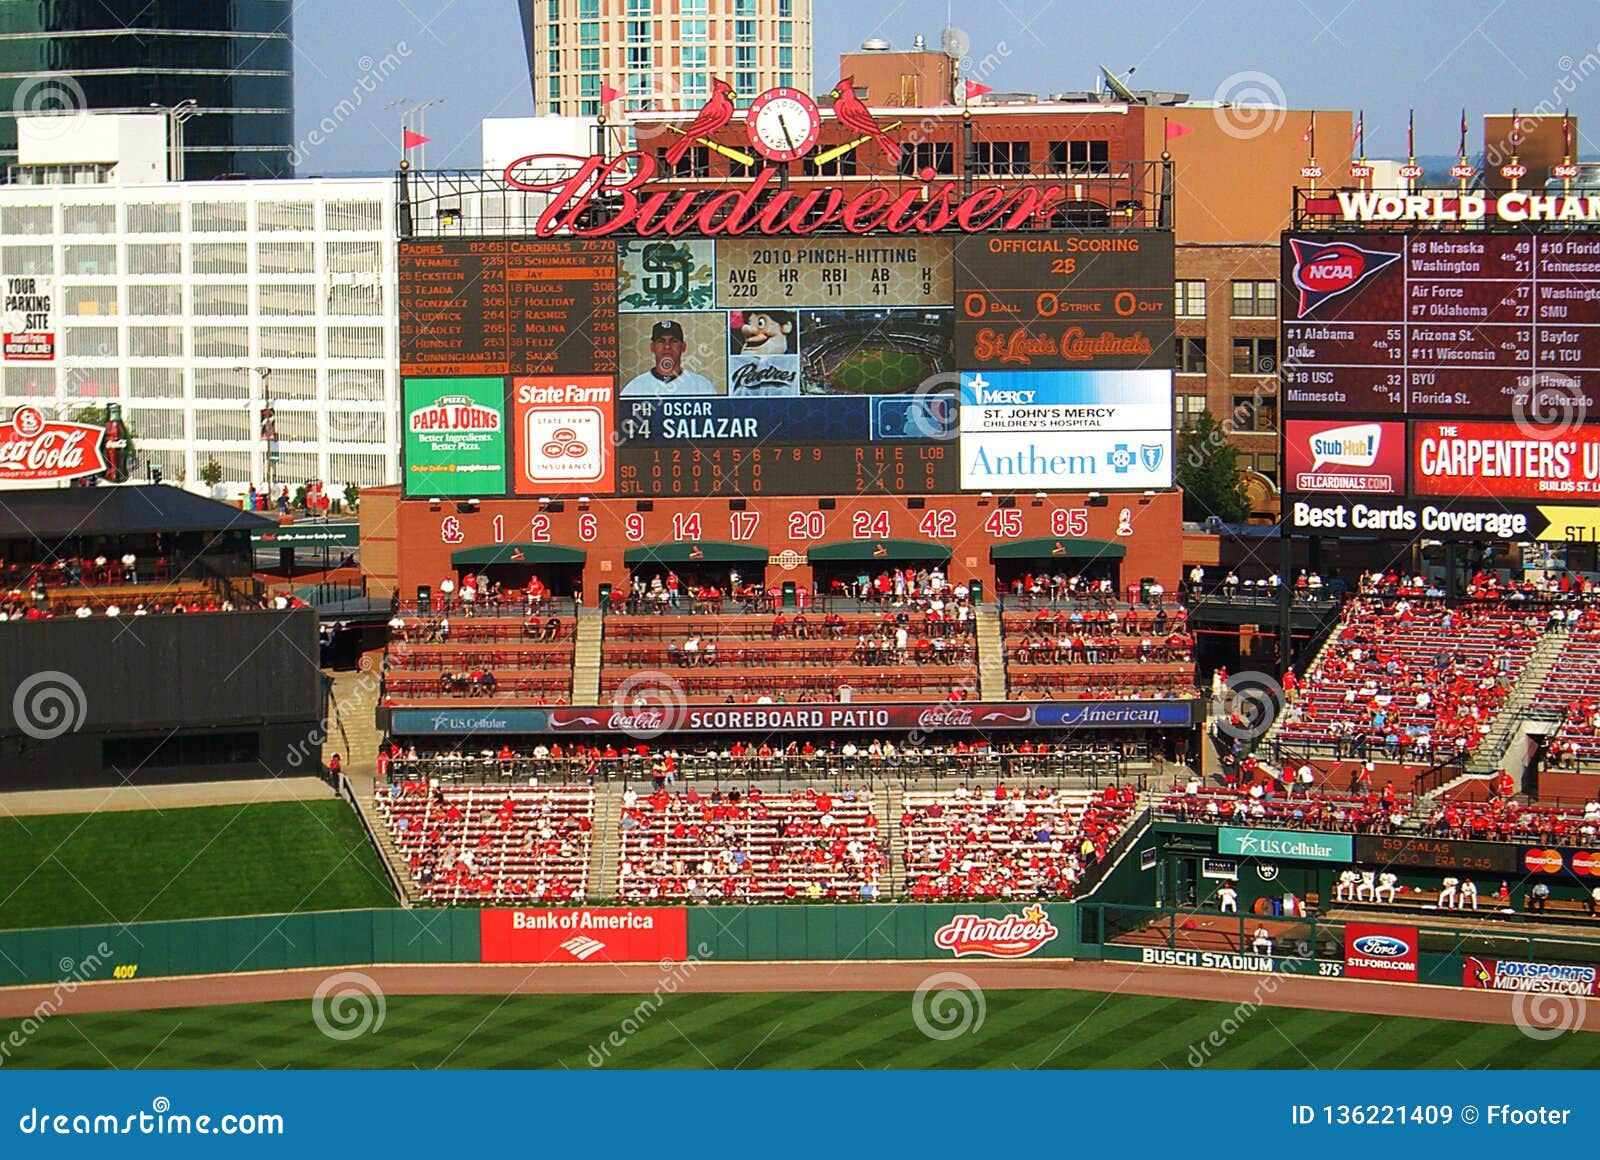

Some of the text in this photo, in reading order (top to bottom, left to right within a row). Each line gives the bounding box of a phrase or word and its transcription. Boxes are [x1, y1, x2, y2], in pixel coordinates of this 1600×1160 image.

[1301, 167, 1321, 177] 1926
[1351, 167, 1369, 177] 1931
[1400, 167, 1421, 177] 1934
[1452, 167, 1472, 176] 1942
[1503, 166, 1524, 176] 1944
[1555, 166, 1577, 176] 1946
[504, 150, 1062, 238] Budweiser
[1337, 192, 1486, 221] WORLD
[511, 241, 571, 253] CARDINALS
[988, 237, 1139, 253] OFFICIAL SCORING
[1411, 241, 1484, 254] #8 Nebraska
[1515, 242, 1530, 254] 49
[1541, 242, 1563, 254] #10
[753, 248, 917, 265] 2010 PINCH-HITTING
[1051, 258, 1076, 274] 2B
[1309, 265, 1353, 279] NCAA
[1412, 260, 1480, 273] Washington
[1515, 261, 1530, 272] 21
[729, 269, 757, 283] AVG
[779, 268, 799, 282] HR
[822, 268, 847, 282] RBI
[872, 268, 890, 281] AB
[922, 267, 931, 281] H
[8, 278, 36, 294] YOUR
[728, 283, 758, 297] .220
[828, 283, 842, 296] 11
[872, 282, 888, 296] 41
[1411, 285, 1464, 297] Air Force
[1516, 287, 1530, 298] 17
[5, 295, 50, 311] PARKING
[991, 303, 1021, 313] BALL
[1060, 302, 1101, 313] STRIKE
[1138, 302, 1164, 311] OUT
[1411, 304, 1488, 316] #7 Oklahoma
[1515, 305, 1530, 317] 27
[1540, 305, 1568, 318] SMU
[26, 313, 48, 329] SITE
[1287, 328, 1354, 340] #1 Alabama
[1387, 329, 1401, 341] 55
[1412, 329, 1475, 341] Arizona St.
[1516, 331, 1530, 342] 13
[1541, 330, 1579, 344] Baylor
[1060, 326, 1152, 361] Cardinals
[1287, 345, 1316, 358] Duke
[1387, 348, 1401, 359] 13
[1412, 348, 1495, 360] #11 Wisconsin
[1515, 349, 1530, 361] 20
[1541, 349, 1581, 361] #4 TCU
[732, 362, 797, 391] Padres
[1287, 372, 1334, 384] #18 USC
[1387, 374, 1401, 386] 32
[1412, 373, 1435, 385] BYU
[1541, 375, 1581, 388] Hawaii
[1287, 390, 1346, 402] Minnesota
[1387, 392, 1401, 403] 14
[1412, 392, 1471, 404] Florida St.
[1515, 395, 1530, 406] 27
[1540, 394, 1594, 407] Colorado
[632, 402, 712, 416] PH OSCAR
[984, 408, 1116, 419] ST. JOHN'S MERCY
[413, 407, 498, 430] PAPA JOHNS
[984, 419, 1103, 429] CHILDREN'S HOSPITAL
[628, 418, 758, 439] 14 SALAZAR
[1439, 426, 1458, 437] THE
[920, 447, 945, 460] LOB
[970, 444, 1097, 476] Anthem
[1420, 438, 1577, 480] CARPENTERS'
[620, 465, 637, 478] SD
[620, 480, 644, 493] STL
[1300, 476, 1388, 490] STLCARDINALS.COM
[1539, 480, 1591, 492] BUILDS ST.
[672, 512, 701, 541] 14
[730, 512, 761, 540] 17
[788, 511, 826, 540] 20
[852, 510, 890, 539] 24
[919, 509, 957, 538] 42
[984, 509, 1023, 538] 45
[1051, 508, 1088, 538] 85
[1293, 502, 1527, 538] Best Cards Coverage
[493, 515, 504, 543] 1
[532, 514, 550, 542] 2
[578, 513, 598, 541] 6
[625, 513, 644, 541] 9
[690, 710, 889, 728] SCOREBOARD PATIO
[1061, 705, 1162, 724] American
[1281, 841, 1332, 857] Cellular
[1407, 841, 1449, 853] SALAS
[512, 910, 654, 929] Bank of America
[1363, 938, 1398, 955] Ford
[1143, 947, 1273, 972] BUSCH STADIUM
[1347, 957, 1415, 972] STLFORD.COM
[1493, 975, 1594, 995] MIDWEST.COM
